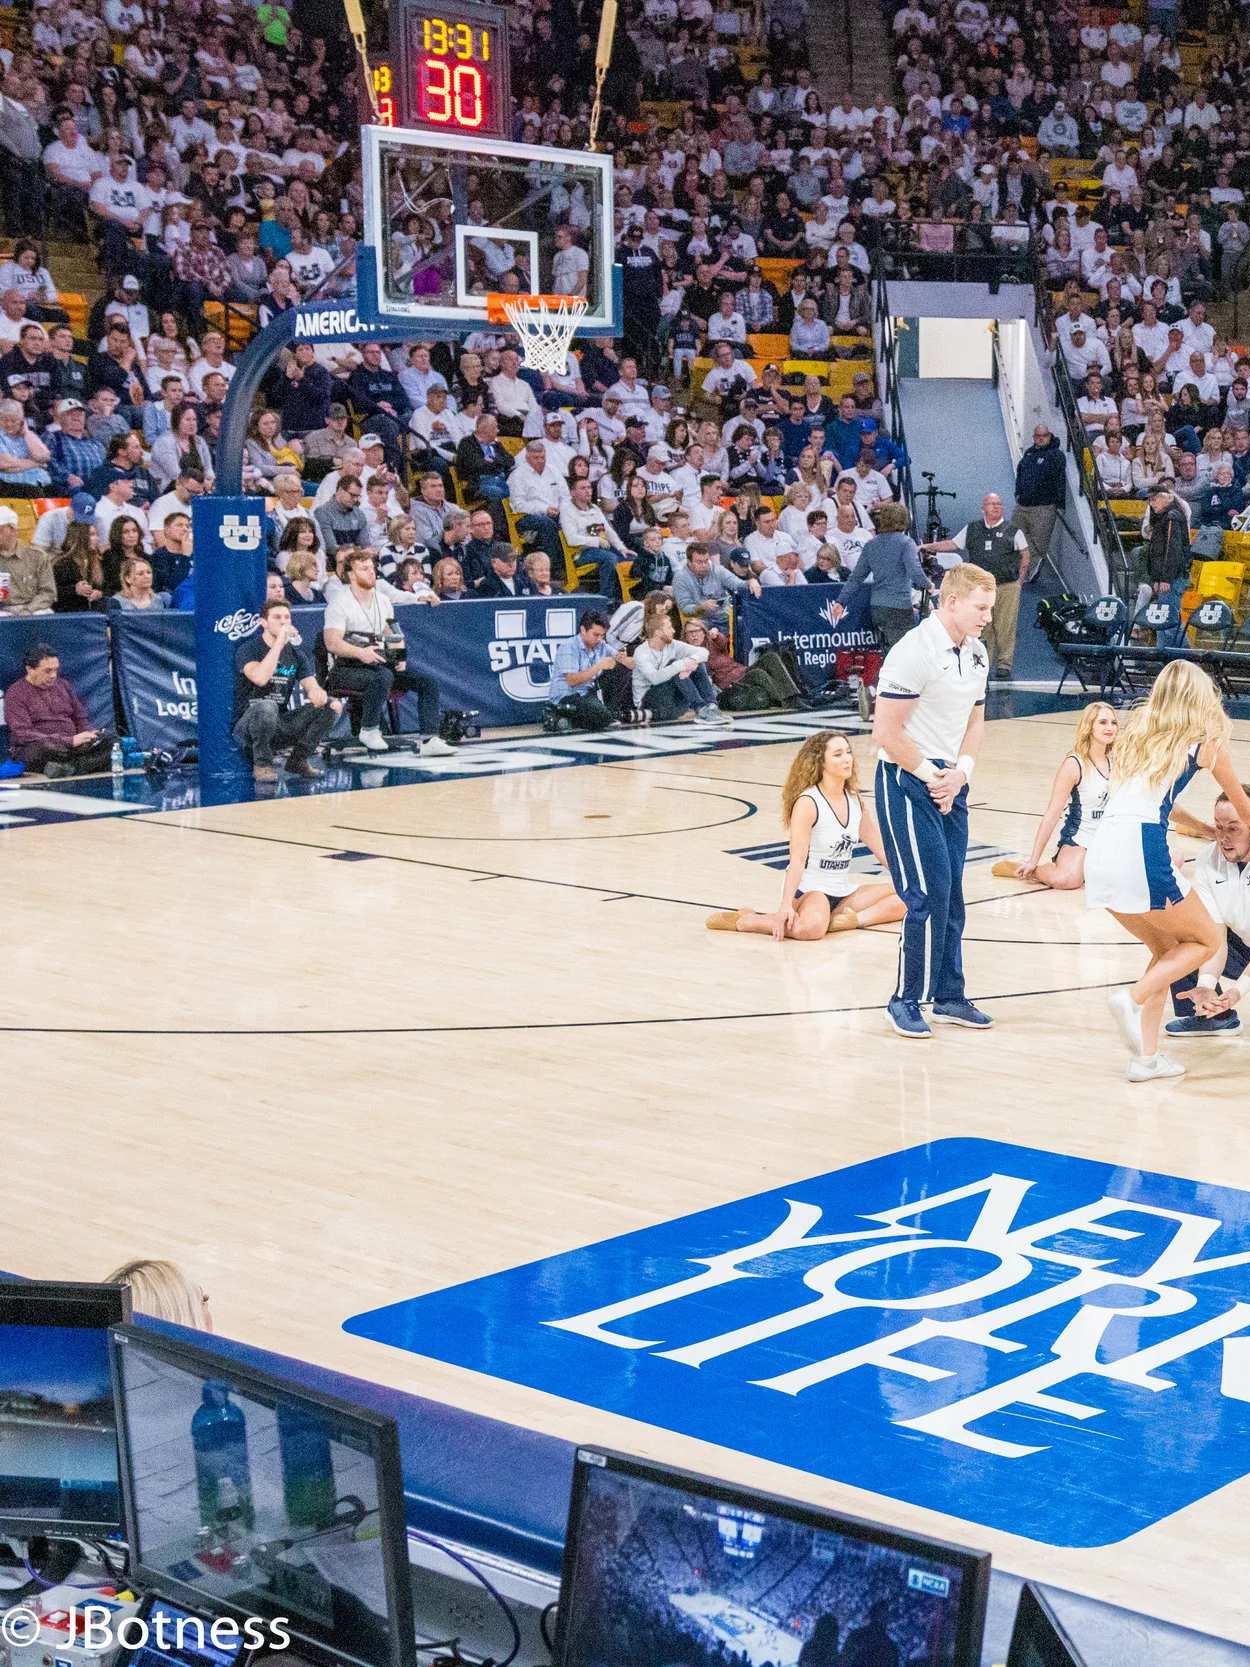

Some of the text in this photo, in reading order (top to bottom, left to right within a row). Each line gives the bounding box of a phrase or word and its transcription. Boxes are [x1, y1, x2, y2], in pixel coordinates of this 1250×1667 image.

[423, 19, 489, 61] 13:31
[426, 59, 482, 127] 30
[488, 638, 564, 672] STAT
[820, 859, 839, 870] UTAH
[539, 1258, 1177, 1458] LIFE
